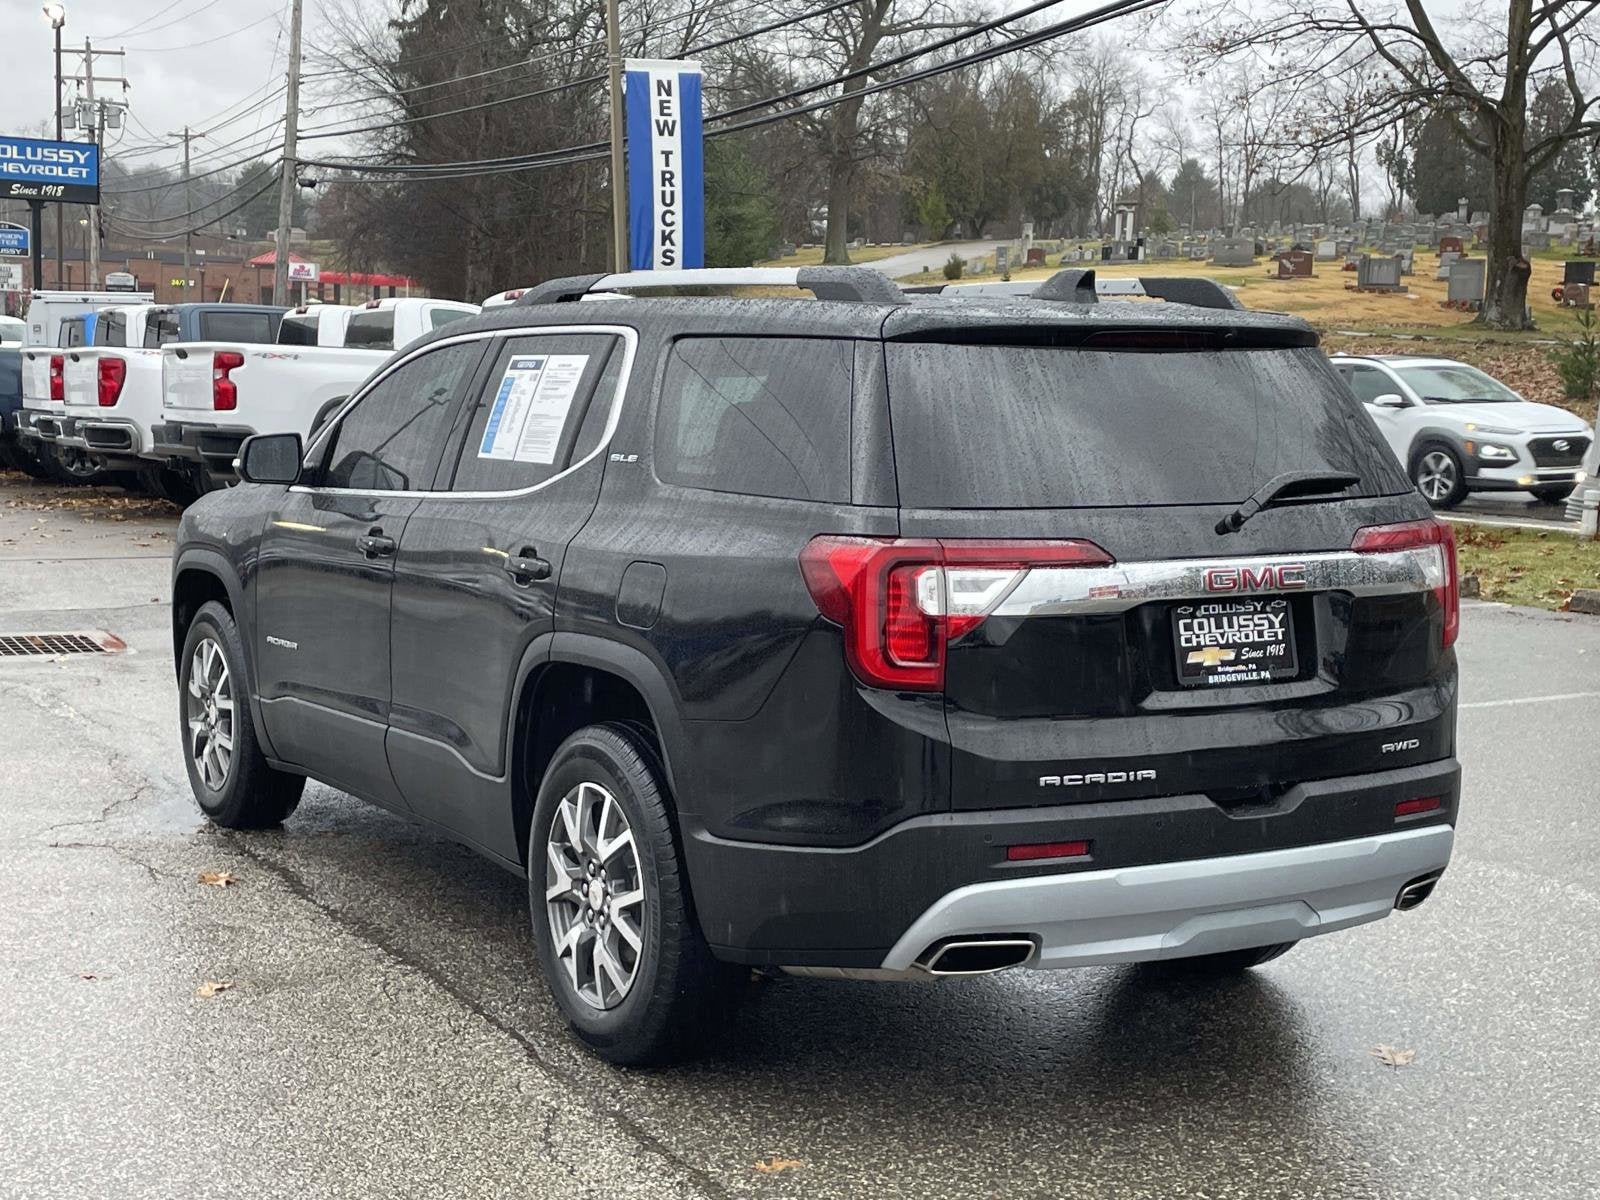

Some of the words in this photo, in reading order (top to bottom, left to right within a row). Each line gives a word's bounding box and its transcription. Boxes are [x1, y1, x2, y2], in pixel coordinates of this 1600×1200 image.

[655, 79, 677, 137] NEW
[10, 183, 38, 195] Since
[41, 185, 65, 197] 1918
[660, 150, 676, 266] TRUCKS
[610, 453, 639, 463] SLE
[1204, 564, 1307, 593] GMC
[1200, 600, 1264, 615] COLUSSY
[1178, 612, 1286, 635] COLUSSY
[1180, 628, 1286, 647] CHEVROLET
[1241, 647, 1264, 660] Since
[1266, 643, 1286, 657] 1918
[1261, 670, 1271, 680] PA
[1382, 739, 1420, 753] AWD
[1039, 770, 1157, 787] ACADIA
